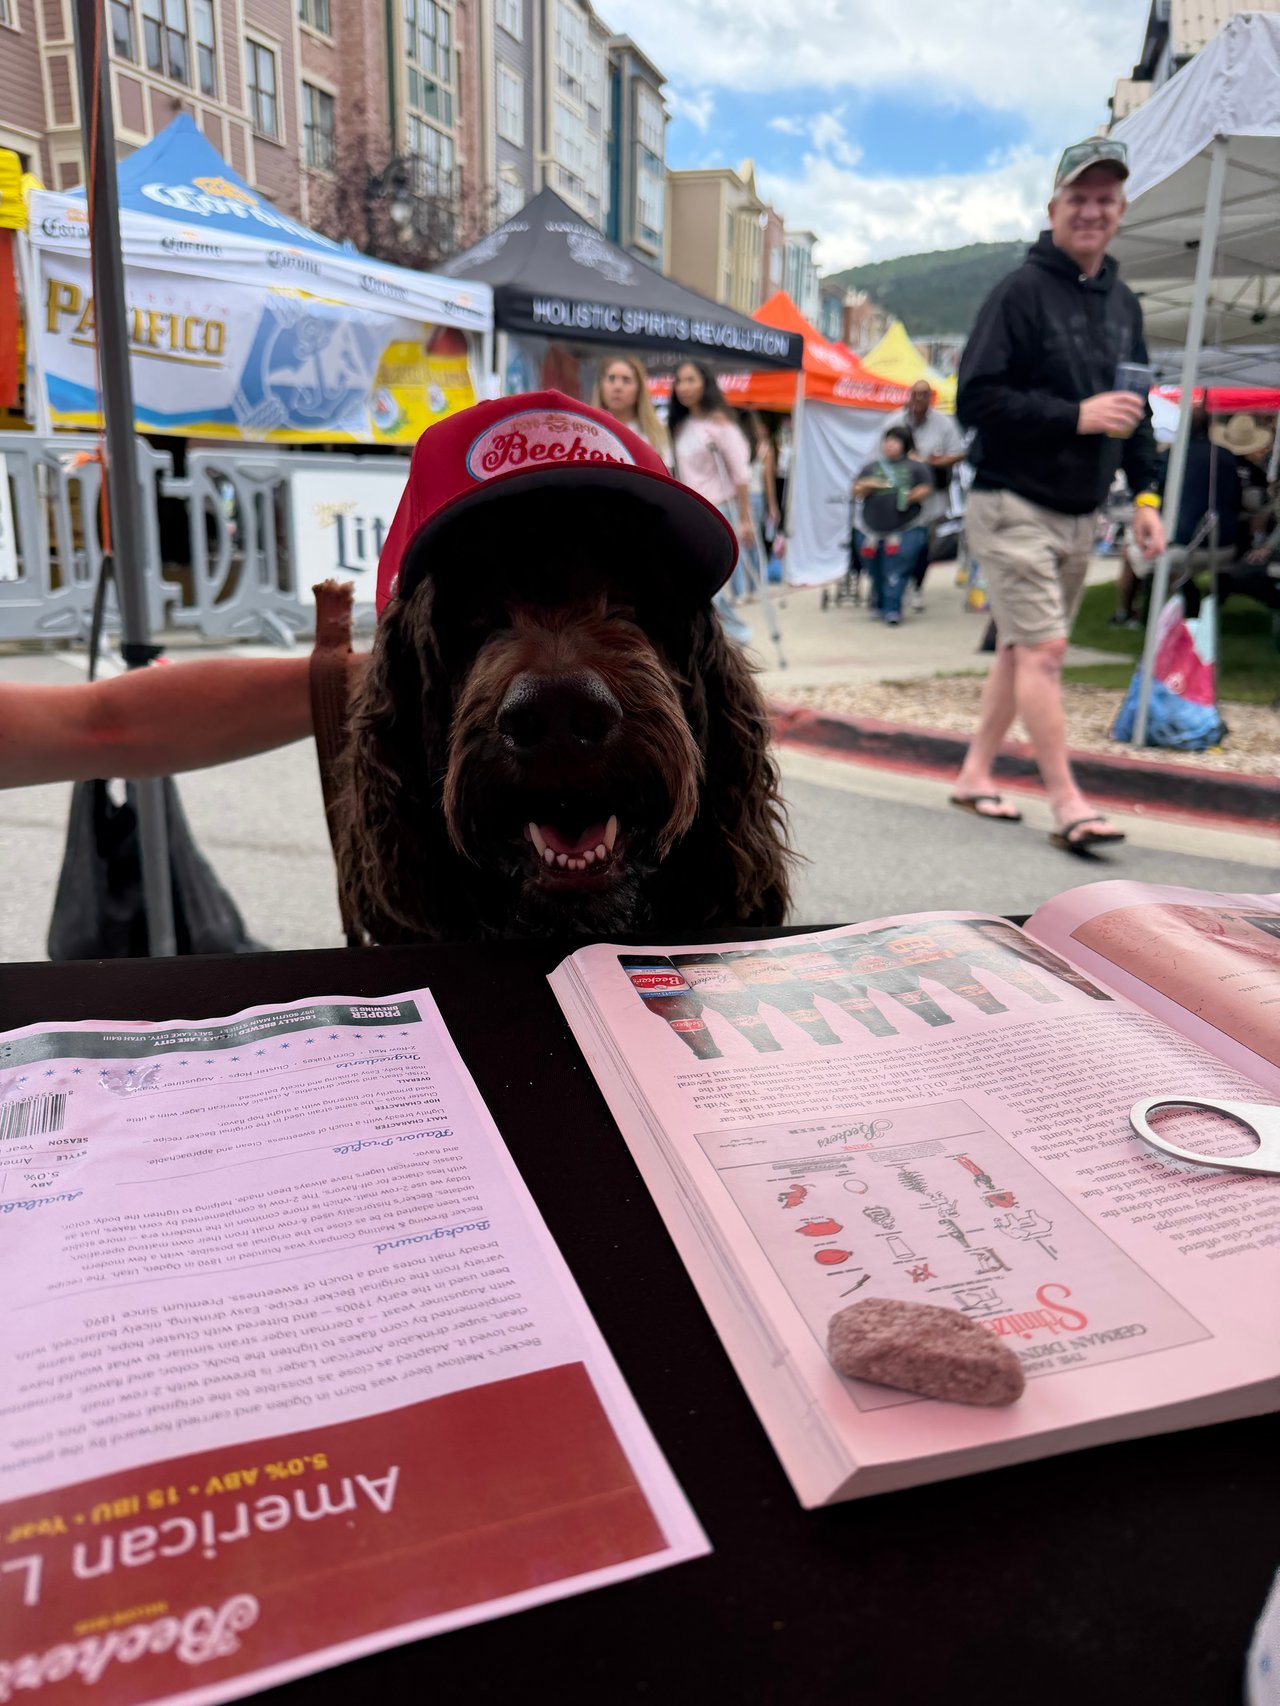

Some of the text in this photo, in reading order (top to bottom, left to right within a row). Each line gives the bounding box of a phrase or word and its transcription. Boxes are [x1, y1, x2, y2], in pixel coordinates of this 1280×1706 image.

[532, 297, 791, 357] HOLISTIC SPIRITS REVOLUTION
[572, 421, 599, 437] 1890
[332, 513, 386, 573] Lit
[632, 976, 680, 986] Becker's
[249, 1017, 271, 1025] MAIN
[272, 1012, 299, 1020] SOUTH
[278, 1014, 316, 1026] LOCALLY
[351, 1011, 401, 1019] PROPER
[238, 1022, 277, 1035] BREWED
[153, 1038, 176, 1047] CITY
[336, 1053, 420, 1070] Ingredients
[1022, 1060, 1048, 1069] lands
[974, 1071, 995, 1079] side
[996, 1066, 1022, 1075] label
[942, 1079, 998, 1092] employees,
[374, 1101, 422, 1110] CHARACTER
[766, 1098, 829, 1109] non-existent
[375, 1119, 424, 1129] CHARACTER
[788, 1126, 826, 1135] BEER
[816, 1118, 894, 1149] Becker's
[48, 1137, 89, 1146] SEASON
[332, 1129, 454, 1155] Flavor Profile
[56, 1150, 88, 1162] STYLE
[1140, 1163, 1165, 1171] Gus
[23, 1171, 60, 1181] 5.0%
[1150, 1168, 1182, 1181] pretty
[30, 1180, 54, 1188] ABV
[1122, 1178, 1151, 1190] hard
[1080, 1190, 1104, 1198] that
[0, 1191, 84, 1214] Availab
[372, 1220, 490, 1254] Background
[459, 1241, 499, 1255] bready
[429, 1252, 456, 1262] malt
[393, 1258, 426, 1270] notes
[367, 1267, 389, 1277] and
[319, 1274, 354, 1286] touch
[304, 1282, 316, 1291] of
[229, 1286, 299, 1301] sweetness.
[163, 1299, 224, 1312] Premium
[122, 1308, 159, 1318] Since
[1018, 1324, 1147, 1361] GERMAN DRIN
[264, 1452, 328, 1480] 5.0%
[204, 1466, 258, 1496] ABV
[146, 1484, 180, 1508] 15
[89, 1494, 140, 1525] IBU
[0, 1465, 400, 1607] American L
